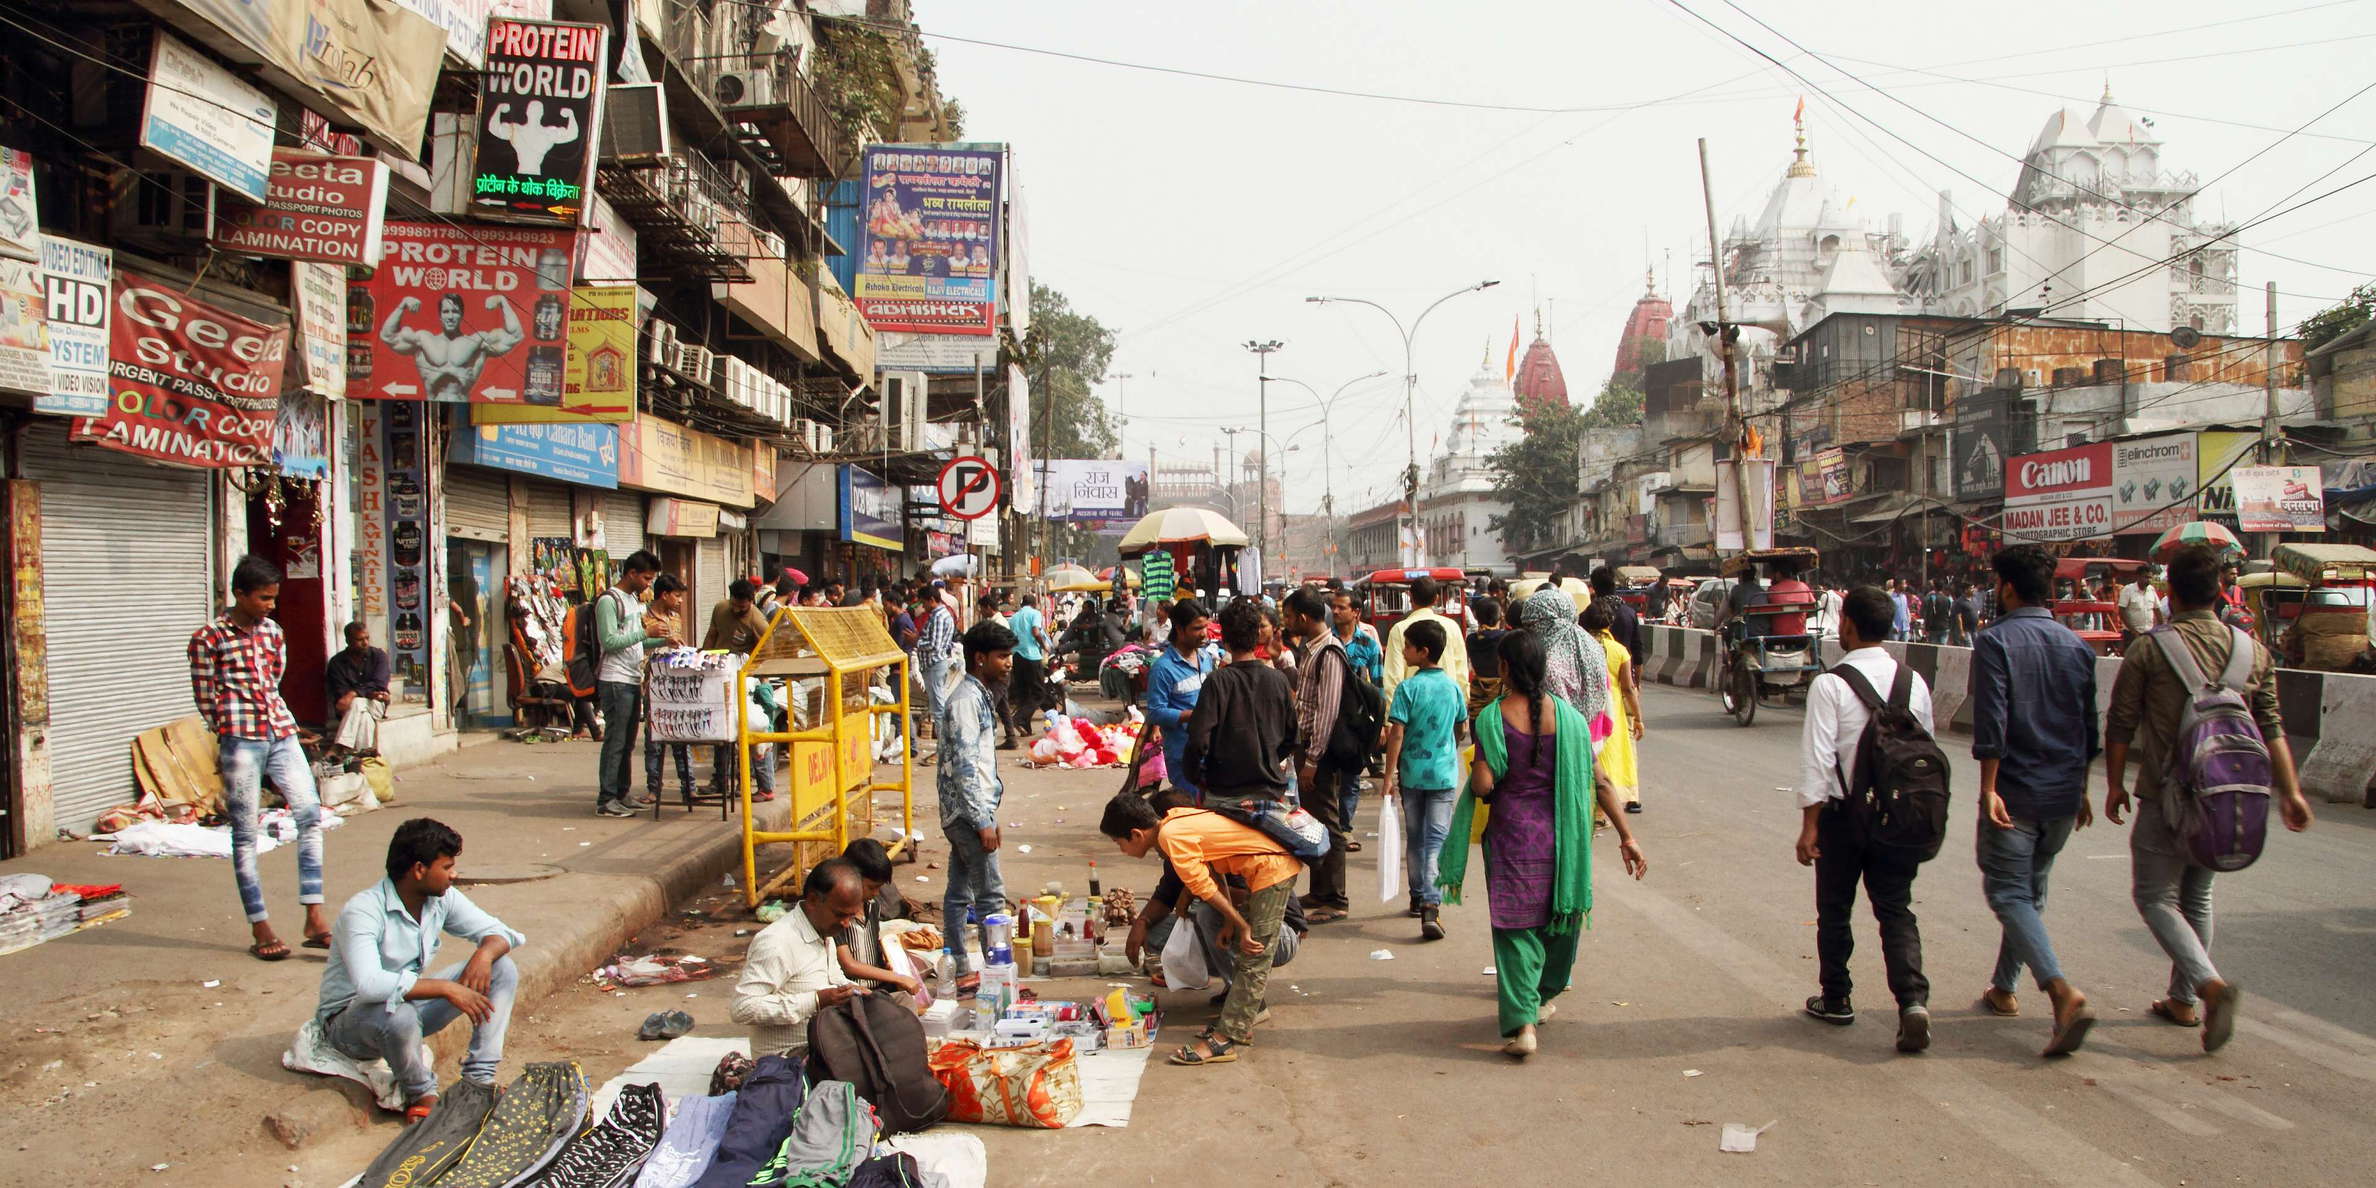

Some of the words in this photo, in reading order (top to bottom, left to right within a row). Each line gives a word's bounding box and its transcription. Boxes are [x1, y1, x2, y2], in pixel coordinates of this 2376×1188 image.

[489, 23, 597, 62] PROTEIN
[489, 61, 591, 100] WORLD
[271, 161, 363, 185] eeta
[266, 182, 345, 204] tudio
[475, 174, 505, 196] प्रोटीन
[507, 176, 519, 194] के
[521, 178, 543, 196] थोक
[546, 177, 580, 200] विक्रेता
[267, 200, 320, 214] PASSPORT
[321, 206, 363, 218] PHOTOS
[947, 195, 992, 211] रामलीला
[301, 219, 361, 238] COPY
[217, 227, 359, 258] LAMINATION
[380, 240, 538, 268] PROTEIN
[42, 240, 70, 273] VIDEO
[865, 282, 890, 292] Ashoka
[892, 283, 924, 293] Electricals
[946, 286, 986, 297] ELECTRICALS
[47, 277, 103, 326] HD
[119, 287, 283, 362] Geeta
[52, 338, 105, 366] YSTEM
[137, 336, 270, 394] Studio
[57, 373, 80, 392] VIDEO
[82, 376, 106, 395] VISION
[173, 378, 247, 406] PASSPORT
[246, 399, 279, 411] PHOTOS
[217, 414, 274, 438] COPY
[578, 425, 597, 451] Bank
[2128, 444, 2179, 460] elinchrom
[1085, 472, 1110, 484] राज
[2021, 457, 2091, 489] Canon
[956, 466, 989, 510] P
[1074, 481, 1118, 498] निवास
[2005, 509, 2044, 530] MADAN
[2047, 507, 2070, 527] JEE
[2074, 506, 2082, 525] &
[2086, 504, 2108, 524] CO.
[2280, 500, 2321, 512] जनसभा
[2016, 528, 2070, 540] PHOTOGRAPHIC
[2073, 526, 2097, 537] STORE
